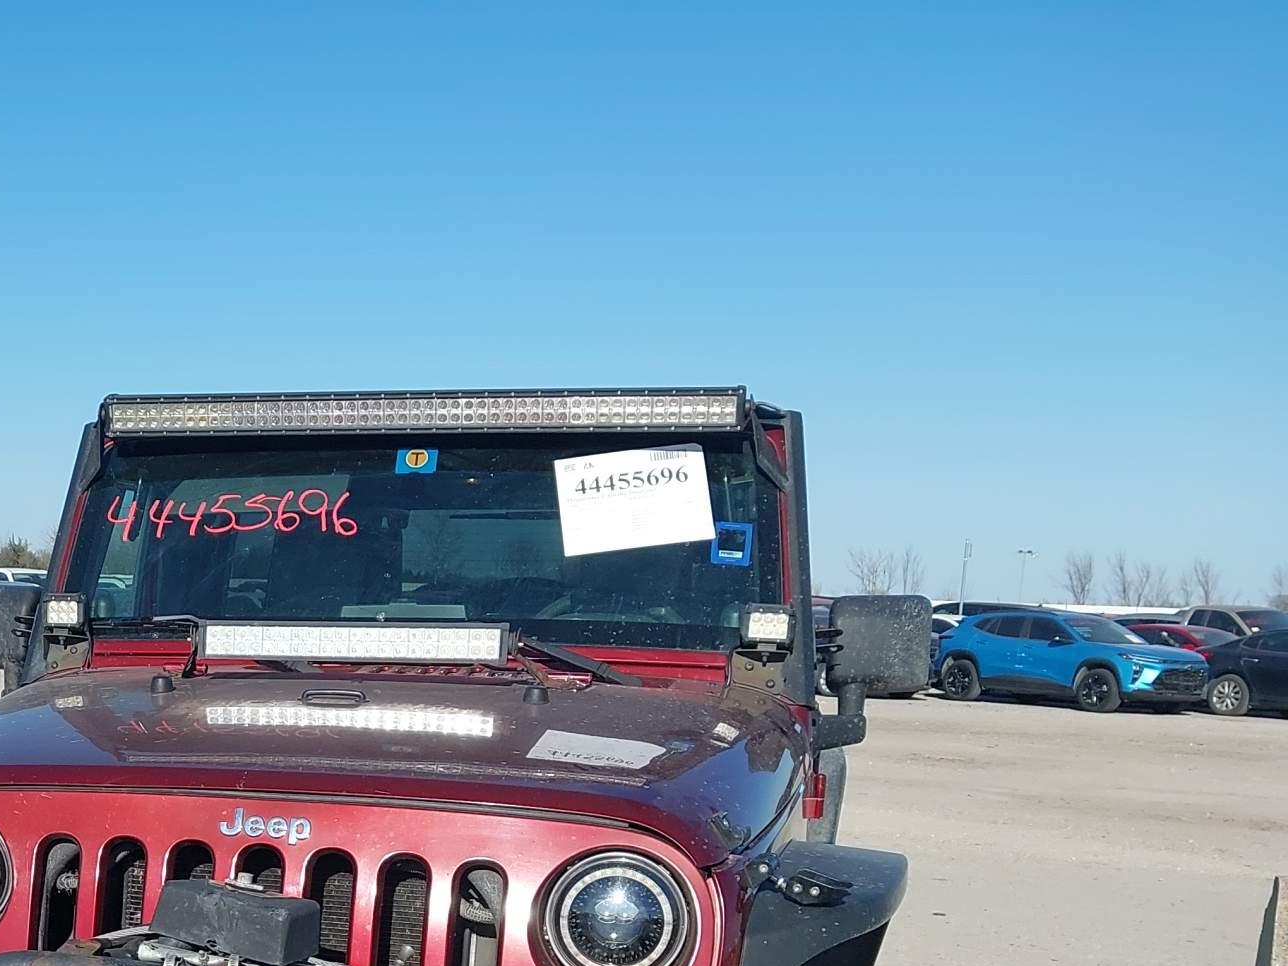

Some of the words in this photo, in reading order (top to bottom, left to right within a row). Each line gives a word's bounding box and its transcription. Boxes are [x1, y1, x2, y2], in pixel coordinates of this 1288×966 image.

[411, 451, 425, 466] T
[575, 464, 689, 494] 44455696
[106, 488, 359, 542] 44455696
[218, 806, 312, 845] Jeep
